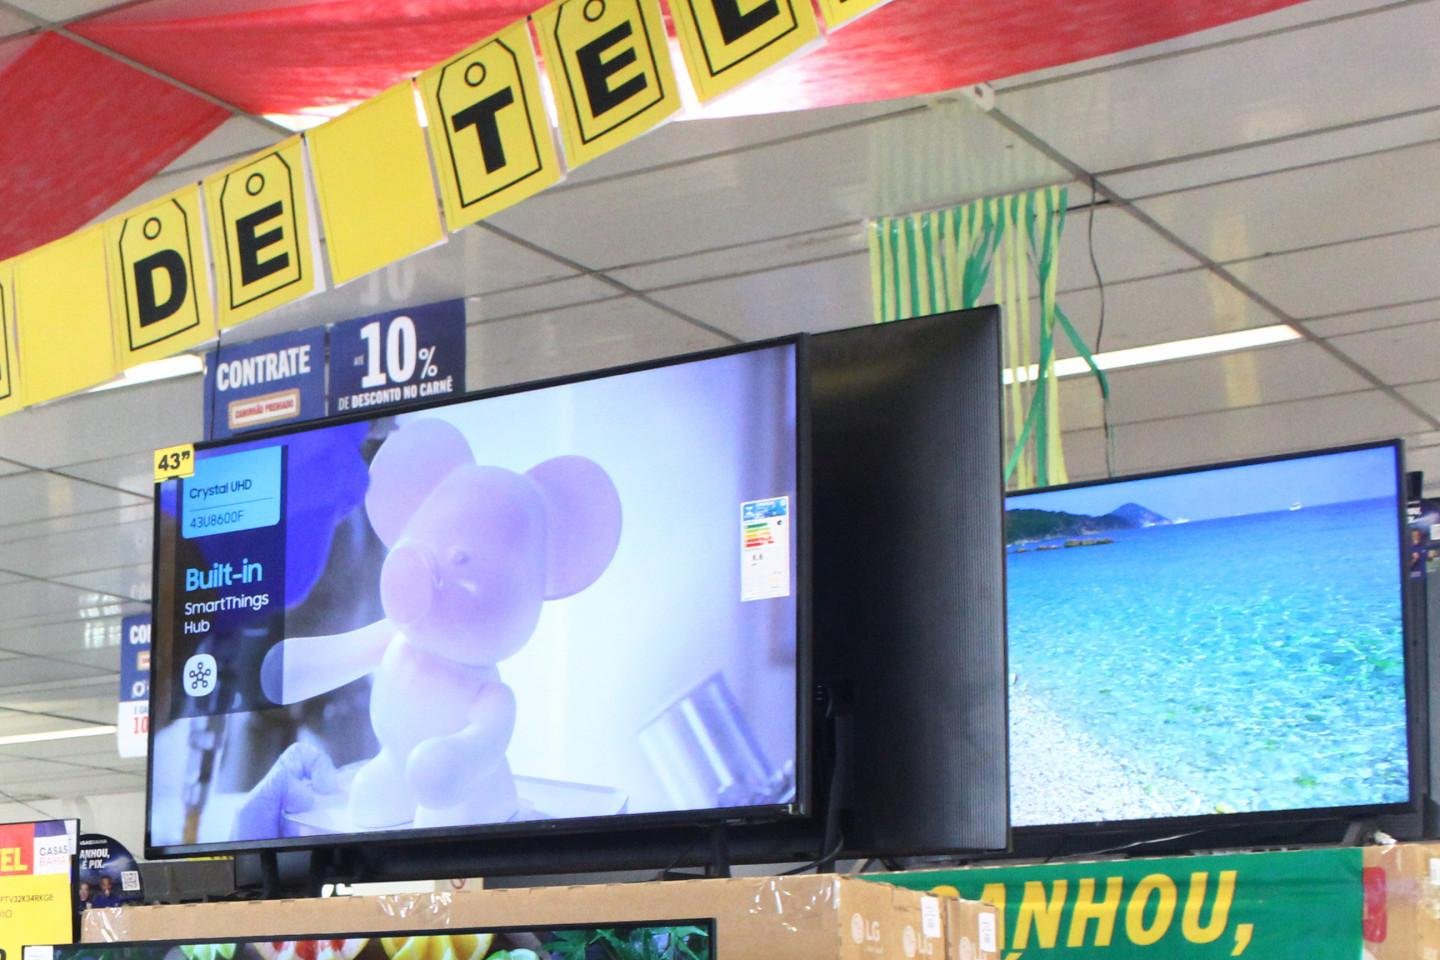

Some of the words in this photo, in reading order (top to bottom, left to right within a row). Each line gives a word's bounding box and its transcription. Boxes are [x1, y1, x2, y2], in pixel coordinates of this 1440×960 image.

[133, 200, 291, 329] DE
[451, 0, 850, 174] TEL
[216, 344, 311, 391] CONTRATE
[338, 396, 350, 411] DE
[351, 389, 402, 409] DESCONTO
[403, 384, 418, 399] NO
[419, 375, 453, 397] CARNÊ
[189, 483, 229, 501] Crystal
[230, 479, 252, 493] UHD
[184, 557, 264, 592] Built-in
[183, 592, 270, 617] SmartThings
[183, 620, 211, 635] Hub
[79, 848, 111, 860] ANHOU,
[931, 870, 1255, 957] ANHOU,
[865, 920, 880, 943] LG
